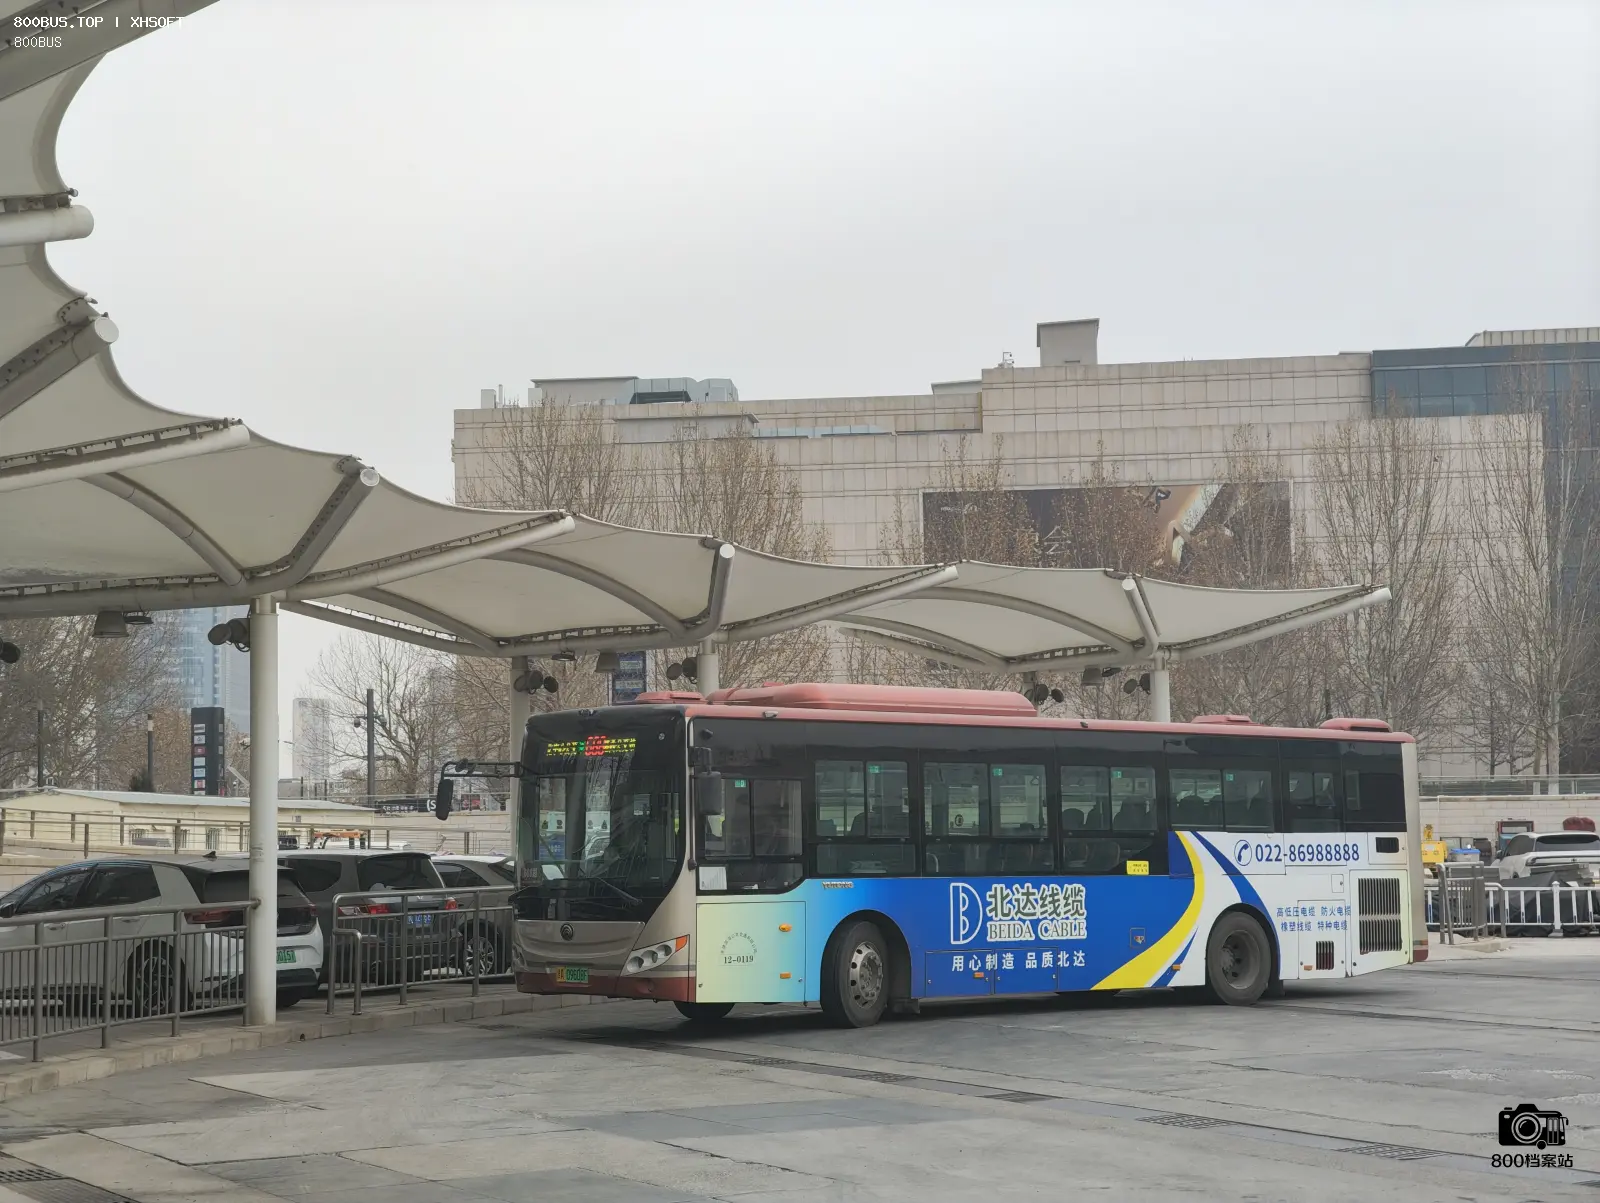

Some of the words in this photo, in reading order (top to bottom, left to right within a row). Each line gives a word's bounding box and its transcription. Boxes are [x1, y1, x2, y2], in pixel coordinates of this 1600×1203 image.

[1255, 843, 1360, 863] 022-86988888
[986, 883, 1087, 920] 北达线缆
[1276, 906, 1315, 917] 高低压电缆
[1320, 905, 1351, 917] 防火电缆
[987, 921, 1035, 942] BEIDA
[1038, 919, 1087, 941] CABLE
[1281, 921, 1312, 932] 橡塑线缆
[1317, 920, 1348, 931] 特种电缆
[724, 955, 754, 964] 12-0119
[952, 953, 1014, 972] 用心制造
[1025, 950, 1086, 969] 品质北达
